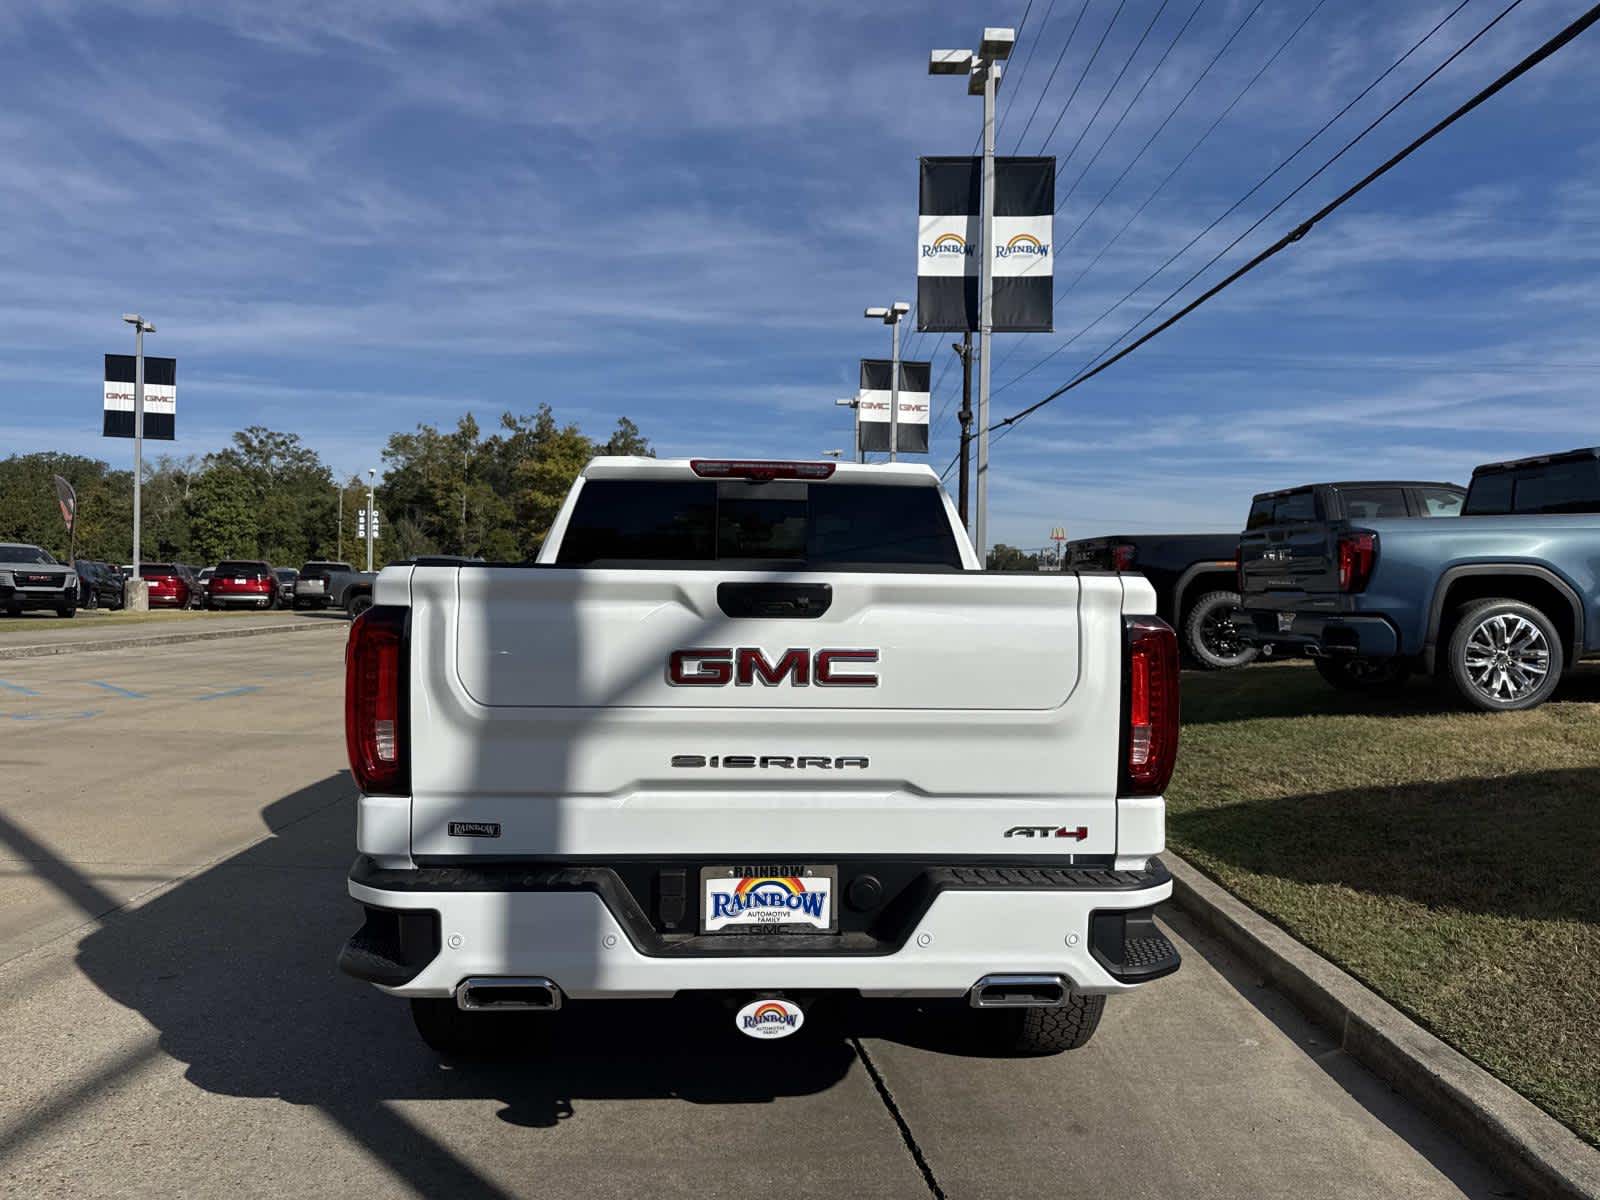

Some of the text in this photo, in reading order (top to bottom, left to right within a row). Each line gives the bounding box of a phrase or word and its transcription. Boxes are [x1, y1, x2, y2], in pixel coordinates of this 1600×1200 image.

[922, 244, 976, 257] RAINBOW
[996, 245, 1050, 257] RAINBOW
[106, 392, 135, 401] GMC
[145, 395, 174, 403] GMC
[861, 402, 890, 410] GMC
[899, 404, 928, 412] GMC
[358, 509, 366, 537] USED
[665, 647, 879, 687] GMC
[671, 755, 869, 769] SIERRA
[454, 823, 496, 835] RAINBOW
[1004, 826, 1088, 842] AT4
[734, 865, 805, 878] RAINBOW
[711, 892, 828, 919] RAINBOW
[748, 925, 790, 934] GMC
[743, 1014, 798, 1029] RAINBOW
